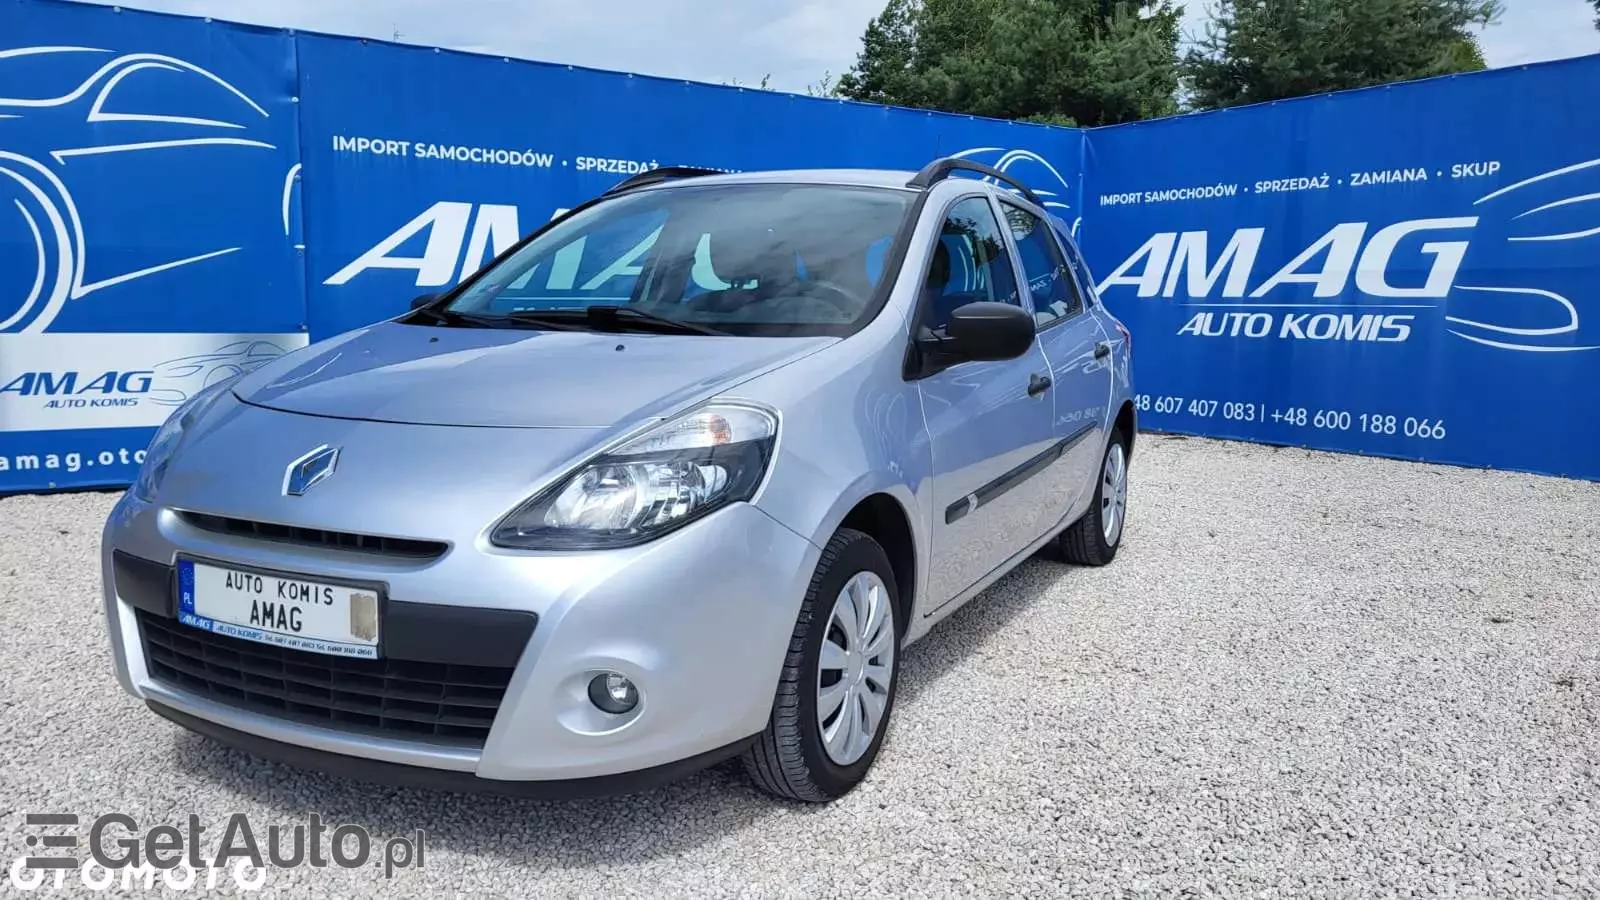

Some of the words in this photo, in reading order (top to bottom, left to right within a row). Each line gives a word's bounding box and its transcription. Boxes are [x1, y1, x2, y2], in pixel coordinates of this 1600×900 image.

[332, 135, 410, 157] IMPORT
[414, 142, 554, 168] SAMOCHODÓW
[575, 156, 659, 174] SPRZEDAŻ
[1099, 189, 1142, 206] IMPORT
[1144, 183, 1238, 203] SAMOCHODÓW
[1254, 172, 1330, 194] SPRZEDAŻ
[1350, 167, 1428, 187] ZAMIANA
[1451, 161, 1501, 179] SKUP
[1096, 216, 1479, 298] AMAG
[1177, 312, 1273, 338] AUTO
[1279, 314, 1415, 342] KOMIS
[0, 370, 154, 396] AMAG
[43, 398, 87, 409] AUTO
[90, 397, 138, 408] KOMIS
[1154, 396, 1183, 414] 607
[1188, 399, 1218, 417] 407
[1223, 402, 1255, 421] 083
[1271, 407, 1308, 427] +48
[1313, 410, 1351, 431] 600
[1361, 413, 1397, 435] 188
[1404, 417, 1446, 439] 066
[183, 592, 192, 605] PL
[225, 571, 263, 594] AUTO
[277, 581, 334, 606] KOMIS
[250, 600, 303, 632] AMAG
